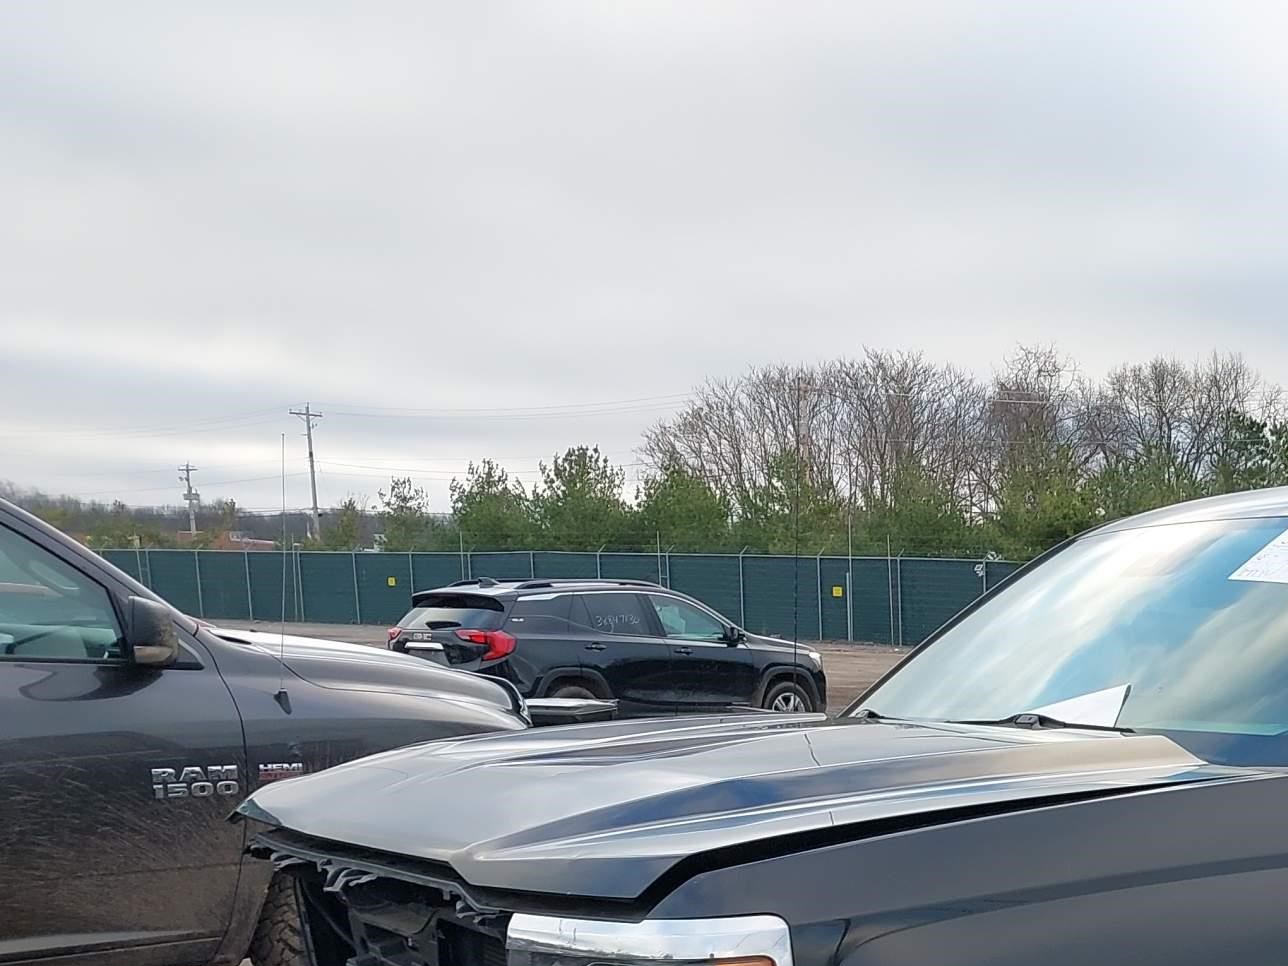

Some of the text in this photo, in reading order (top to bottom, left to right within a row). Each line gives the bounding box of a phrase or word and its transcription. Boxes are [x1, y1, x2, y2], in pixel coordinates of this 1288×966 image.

[151, 764, 239, 783] RAM
[258, 762, 303, 771] HEMI
[152, 781, 239, 799] 1500
